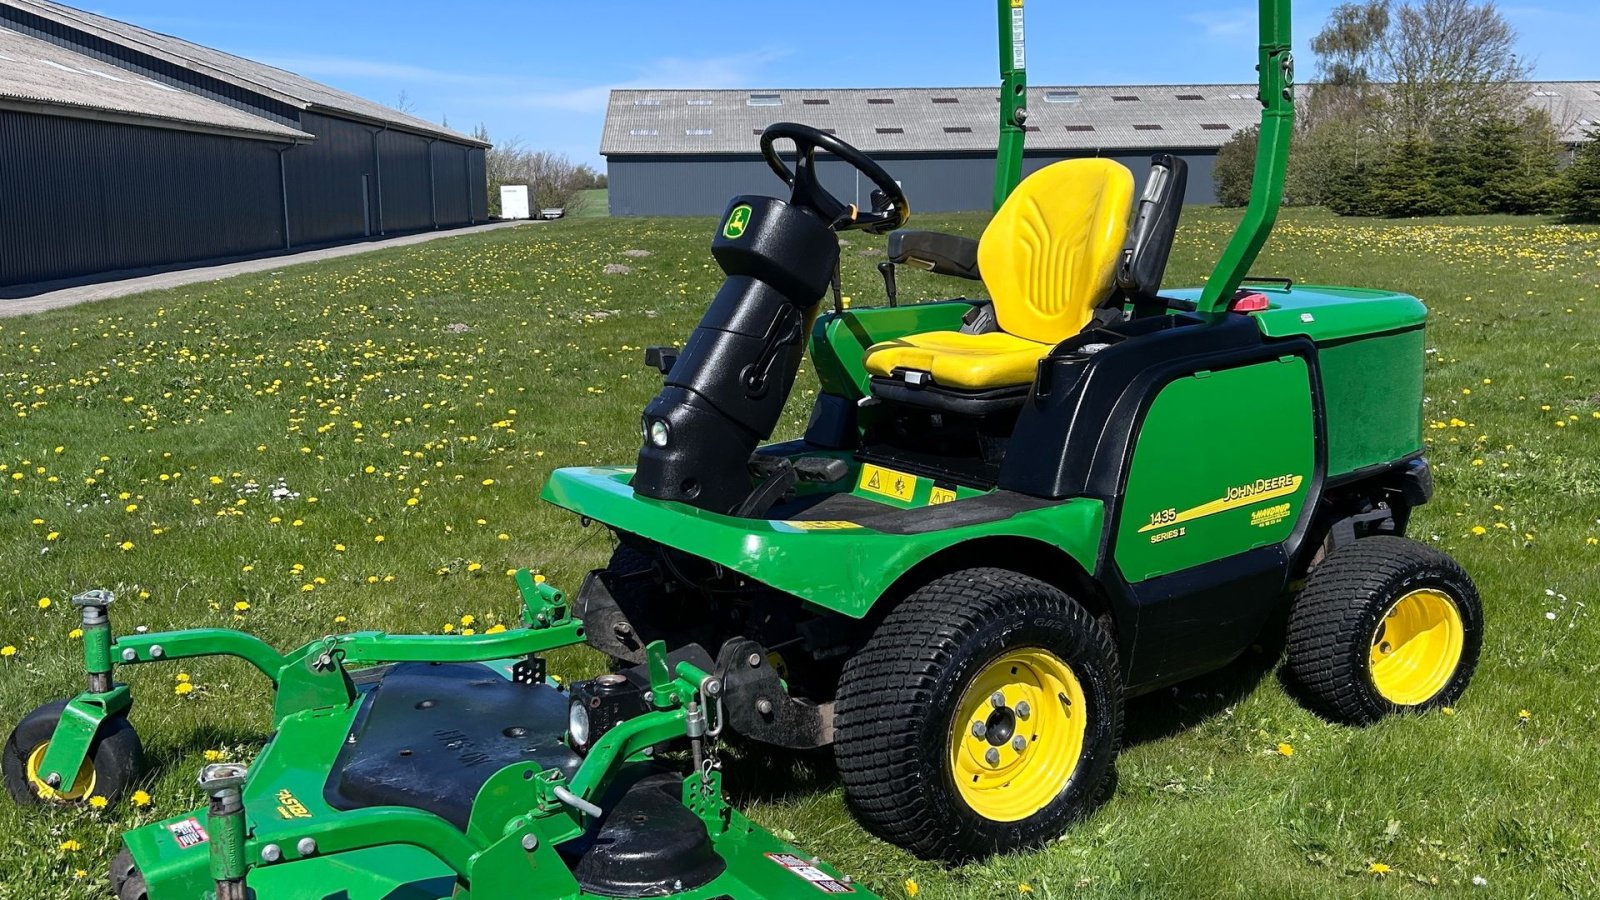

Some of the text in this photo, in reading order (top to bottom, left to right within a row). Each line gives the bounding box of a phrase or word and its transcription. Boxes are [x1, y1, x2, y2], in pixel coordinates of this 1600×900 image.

[1223, 474, 1293, 501] JOHN DEERE
[1150, 508, 1176, 524] 1435
[1150, 527, 1186, 543] SERIES II
